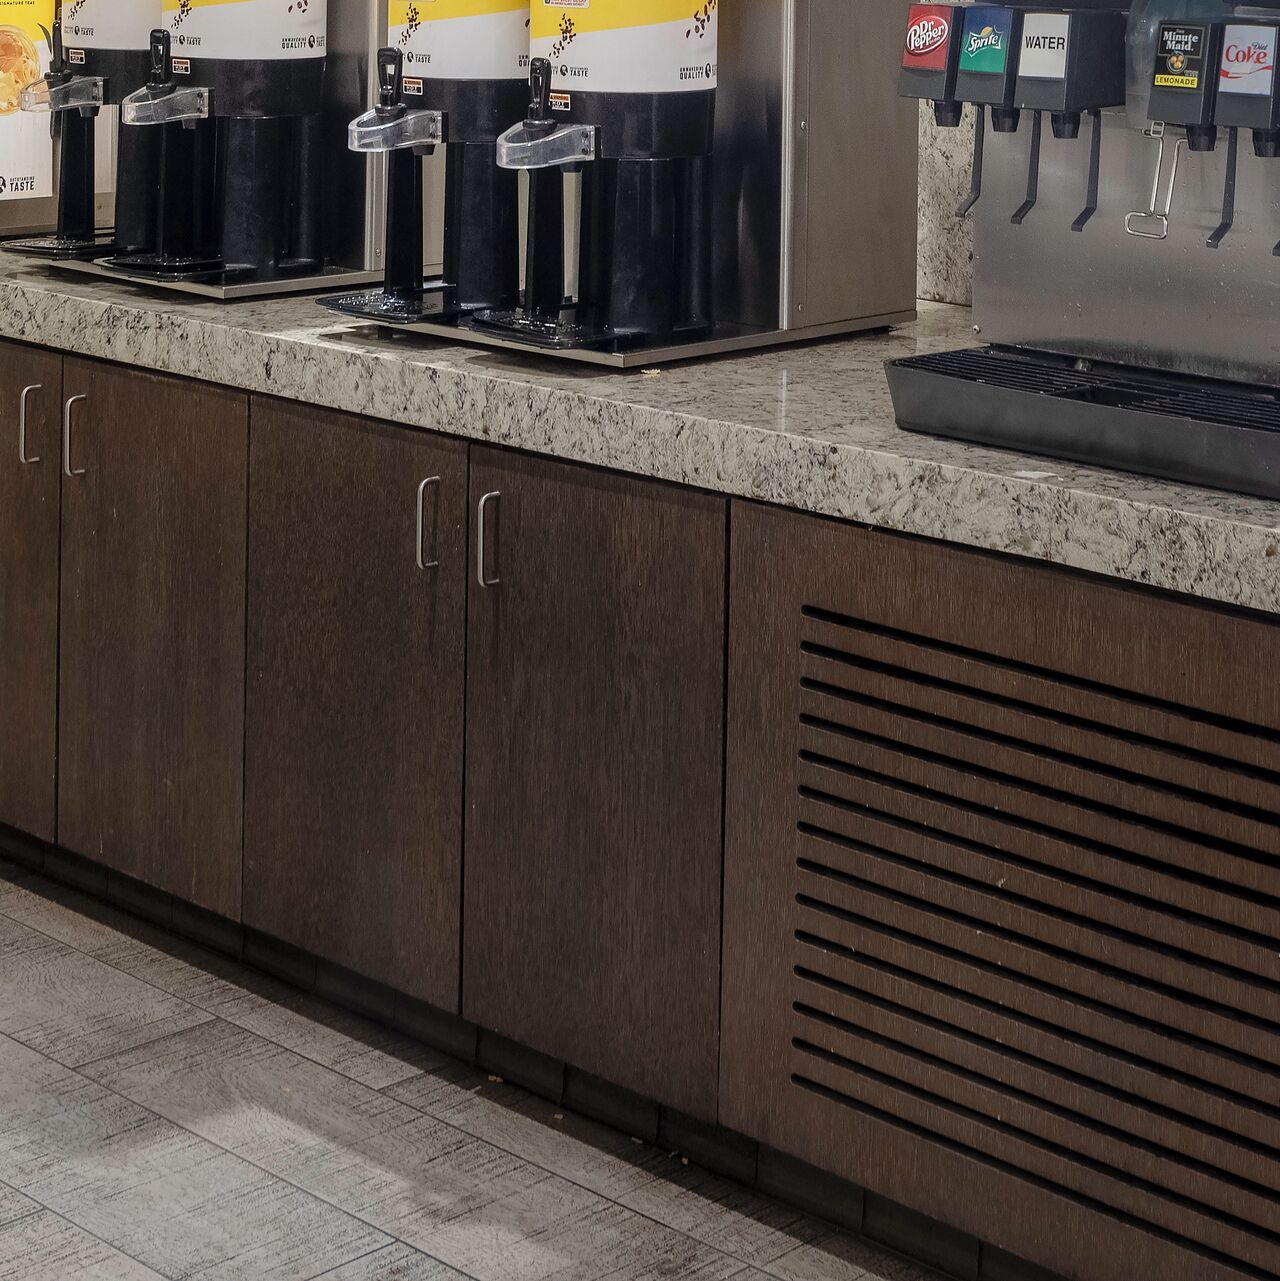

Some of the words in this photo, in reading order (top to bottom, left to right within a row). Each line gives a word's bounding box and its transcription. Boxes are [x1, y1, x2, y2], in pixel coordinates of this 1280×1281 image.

[920, 20, 934, 34] Dr
[908, 25, 945, 51] Pepper
[968, 33, 999, 52] Sprite
[1163, 31, 1199, 42] Minute
[1025, 36, 1065, 50] WATER
[1251, 42, 1268, 50] Diet
[1225, 44, 1268, 64] Coke
[680, 71, 703, 80] QUALITY
[1156, 76, 1195, 86] LEMONADE
[10, 181, 35, 192] TASTE
